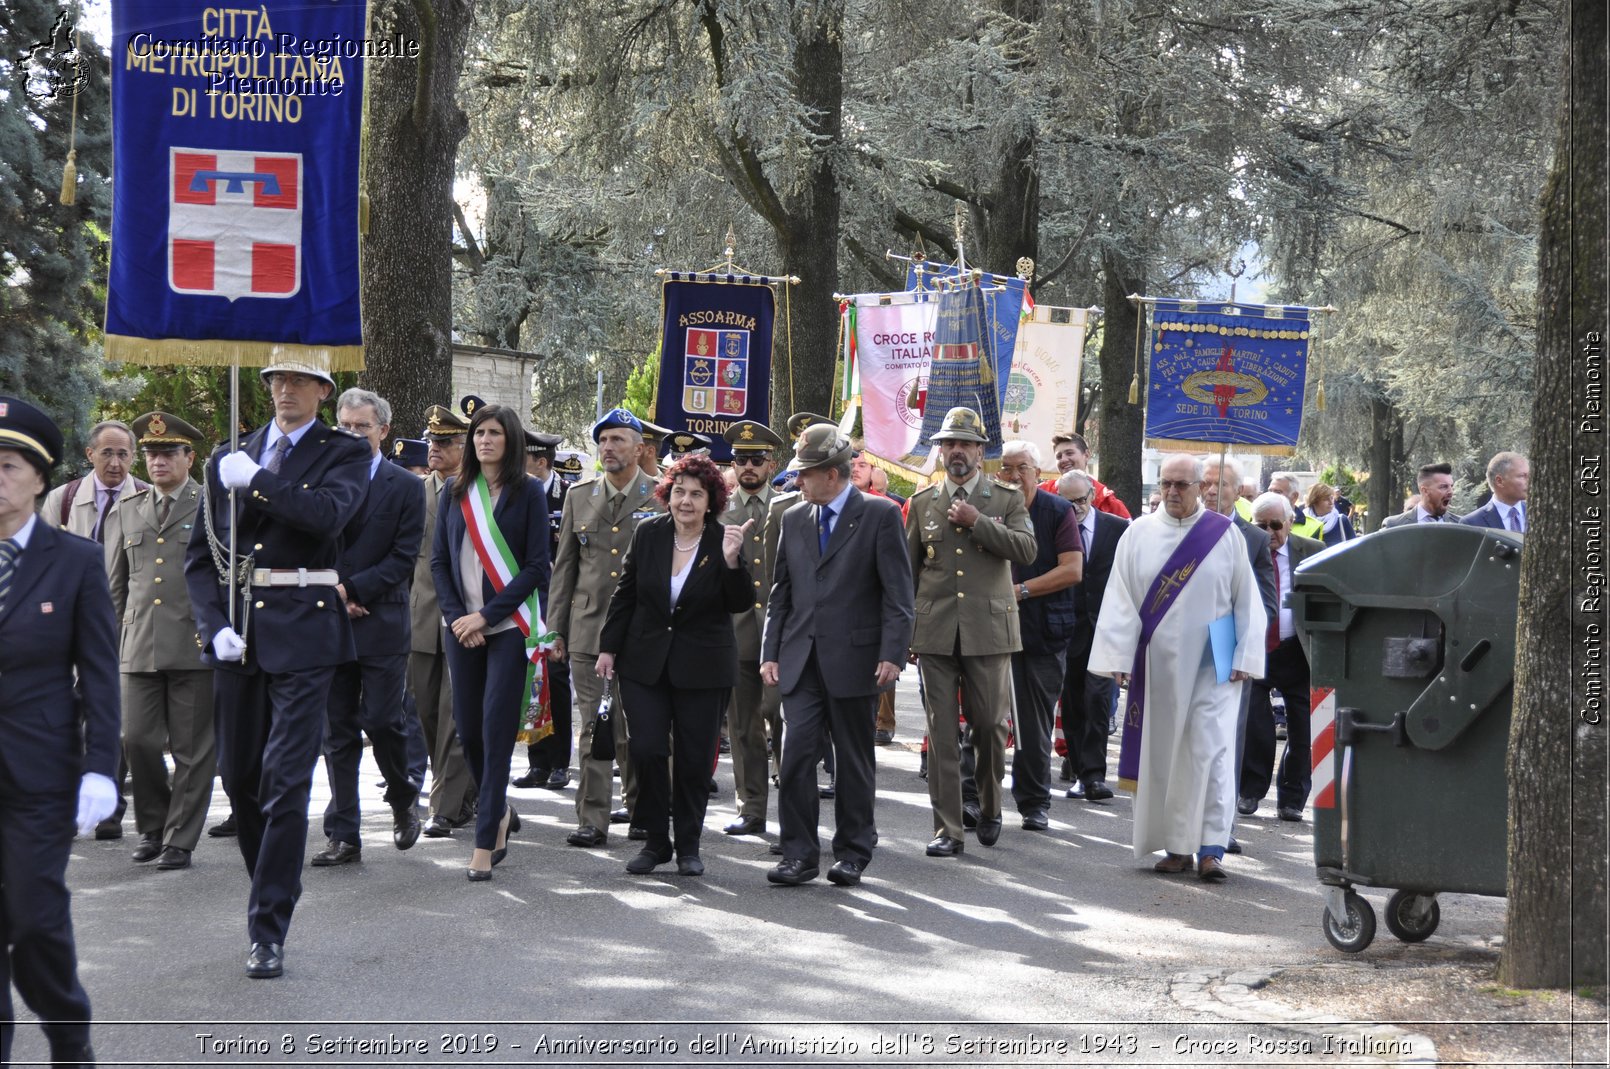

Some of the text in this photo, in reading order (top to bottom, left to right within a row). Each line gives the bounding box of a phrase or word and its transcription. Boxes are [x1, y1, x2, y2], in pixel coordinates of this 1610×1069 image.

[203, 5, 273, 40] CITTÀ
[126, 43, 344, 84] METROPOLITANA
[172, 88, 302, 123] DI TORINO
[679, 310, 756, 331] ASSOARMA
[873, 333, 917, 345] CROCE
[891, 346, 933, 360] ITALIA
[1194, 347, 1226, 357] FAMIGLIE
[1231, 348, 1261, 362] MARTIRI
[1264, 357, 1271, 365] E
[1272, 362, 1298, 379] CADUTI
[885, 362, 921, 370] COMITATO
[1022, 362, 1042, 387] Carcere
[1161, 357, 1289, 387] PER LA CAUSA DI LIBERAZIONE
[1175, 403, 1268, 420] SEDE DI TORINO
